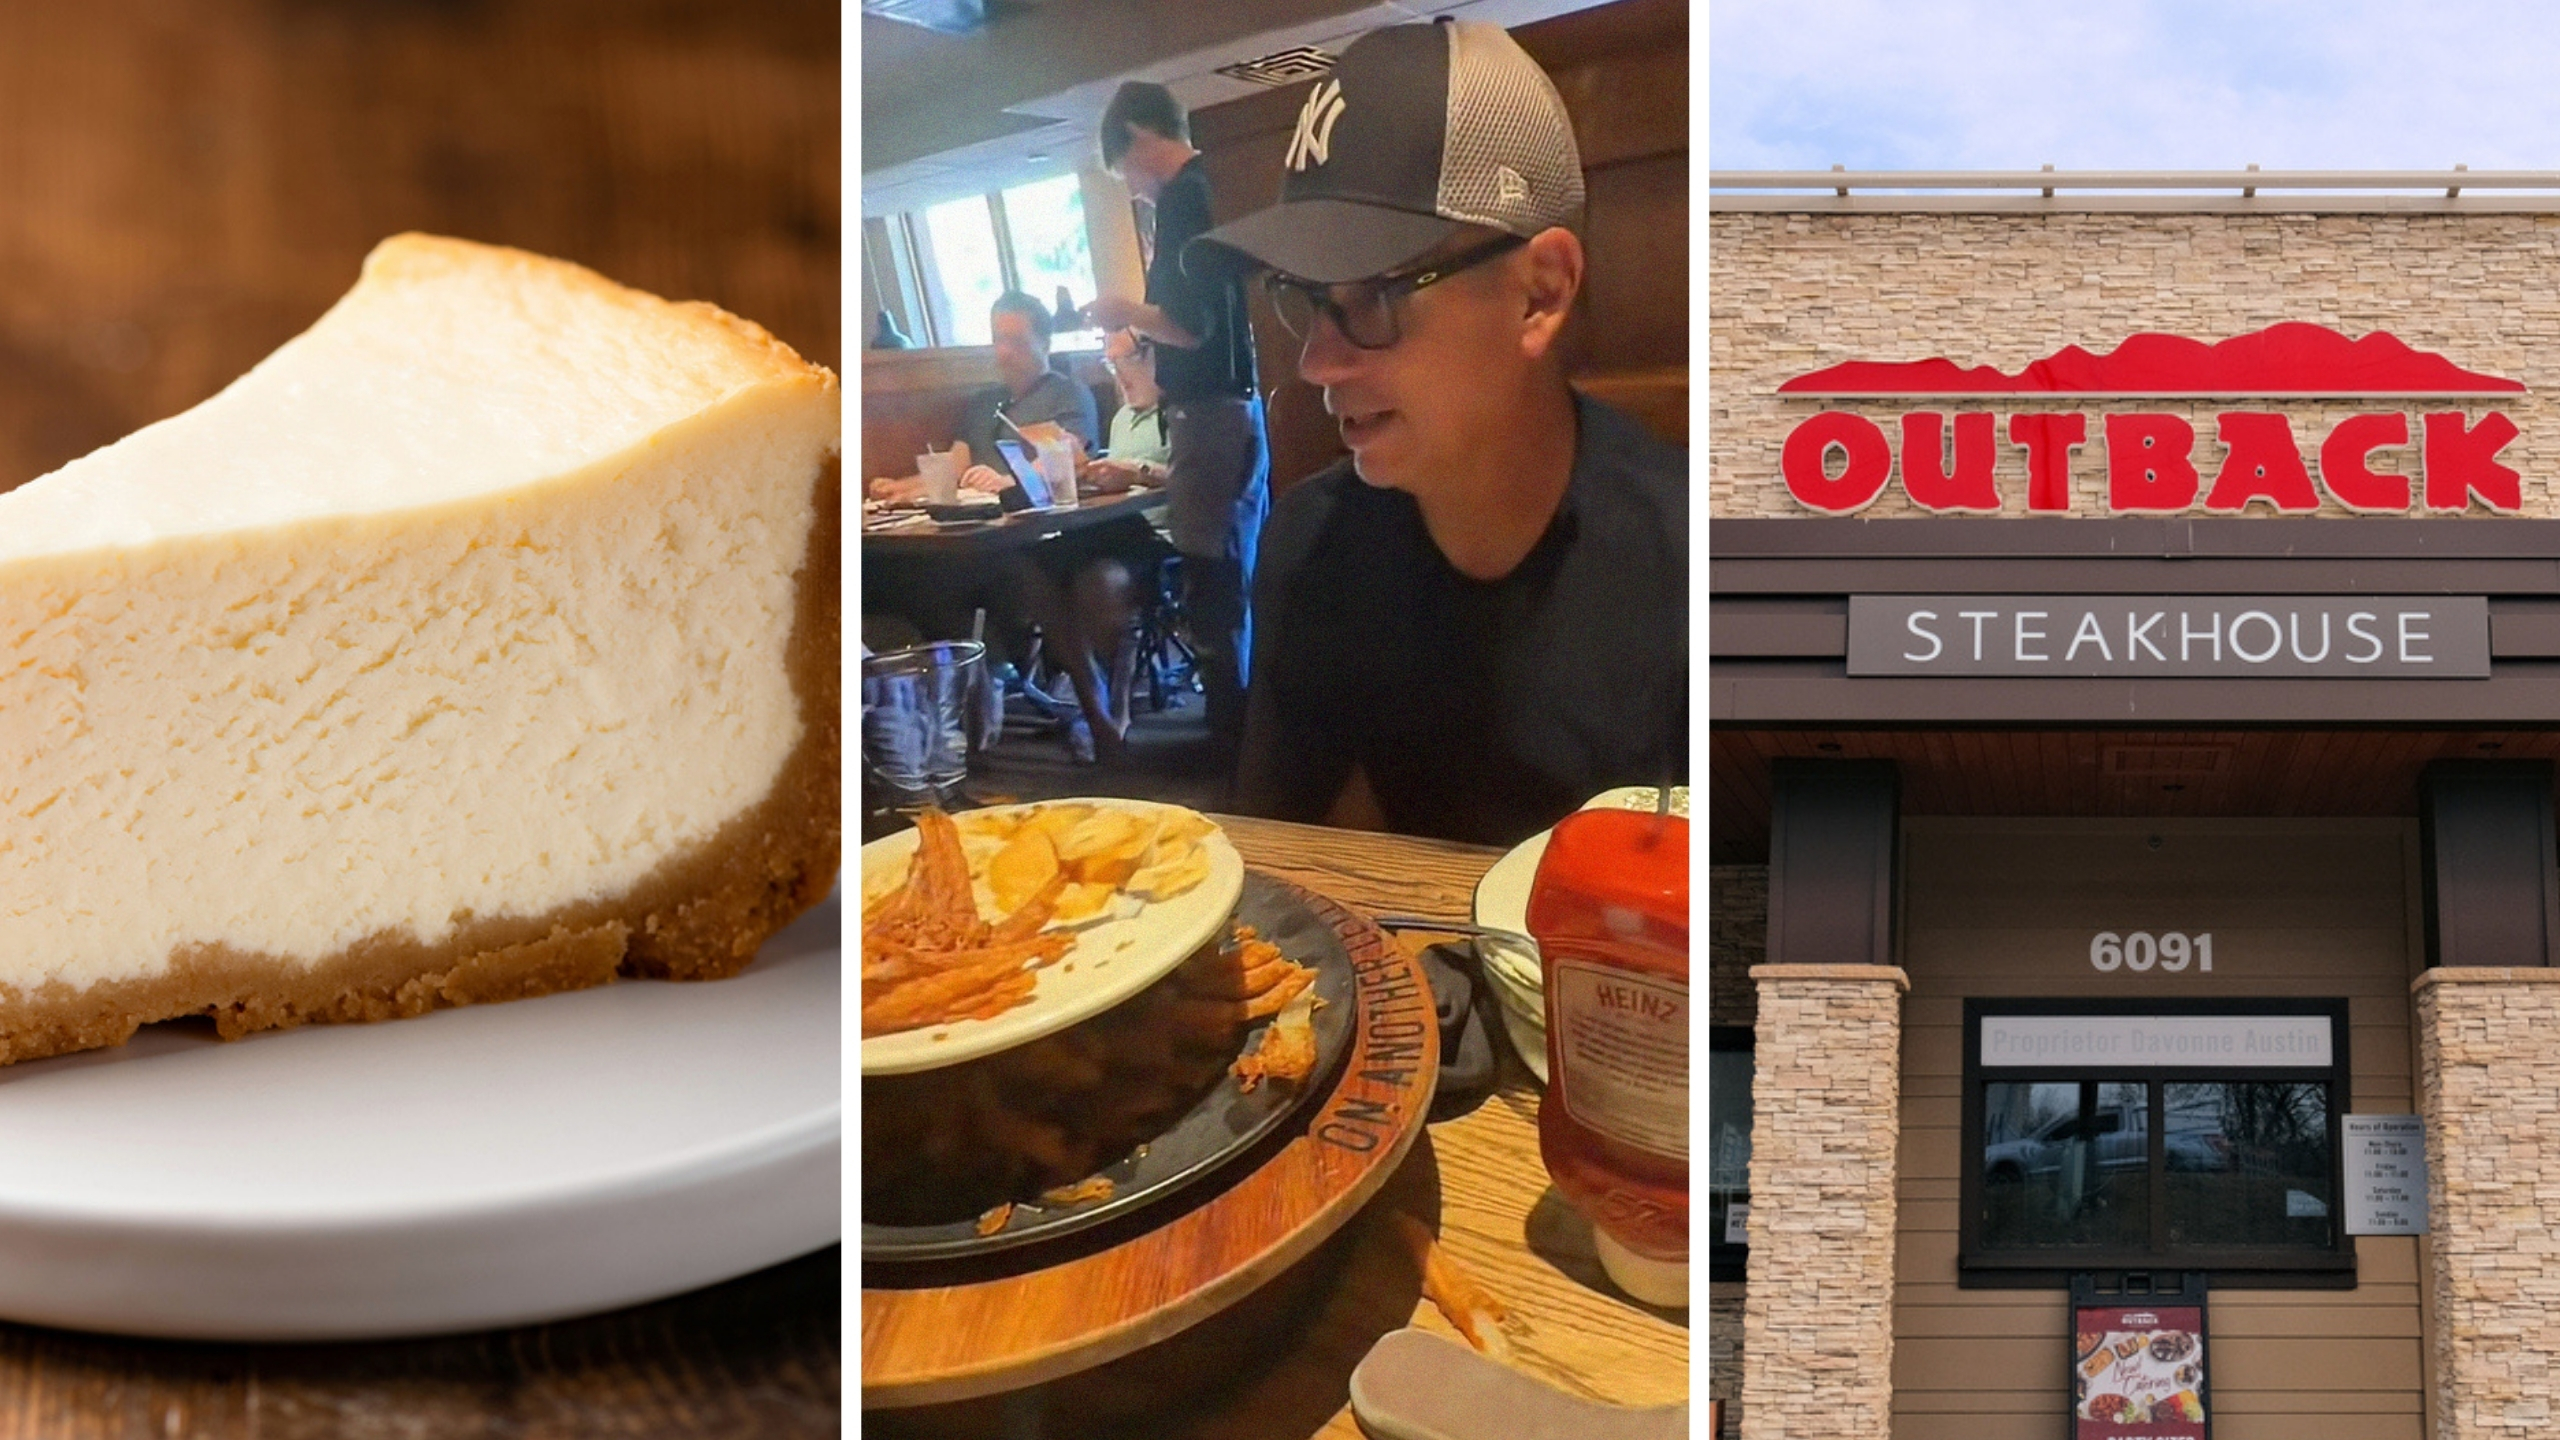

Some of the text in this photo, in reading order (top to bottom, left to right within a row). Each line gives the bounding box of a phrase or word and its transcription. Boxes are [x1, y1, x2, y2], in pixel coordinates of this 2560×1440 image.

[1781, 411, 2522, 515] OUTBACK
[1903, 611, 2434, 664] STEAKHOUSE
[2090, 931, 2212, 972] 6091
[1597, 984, 1679, 1021] HEINZ
[1317, 950, 1425, 1152] ON ANOTHER
[1992, 1029, 2319, 1056] Proprietor Davonne Austin
